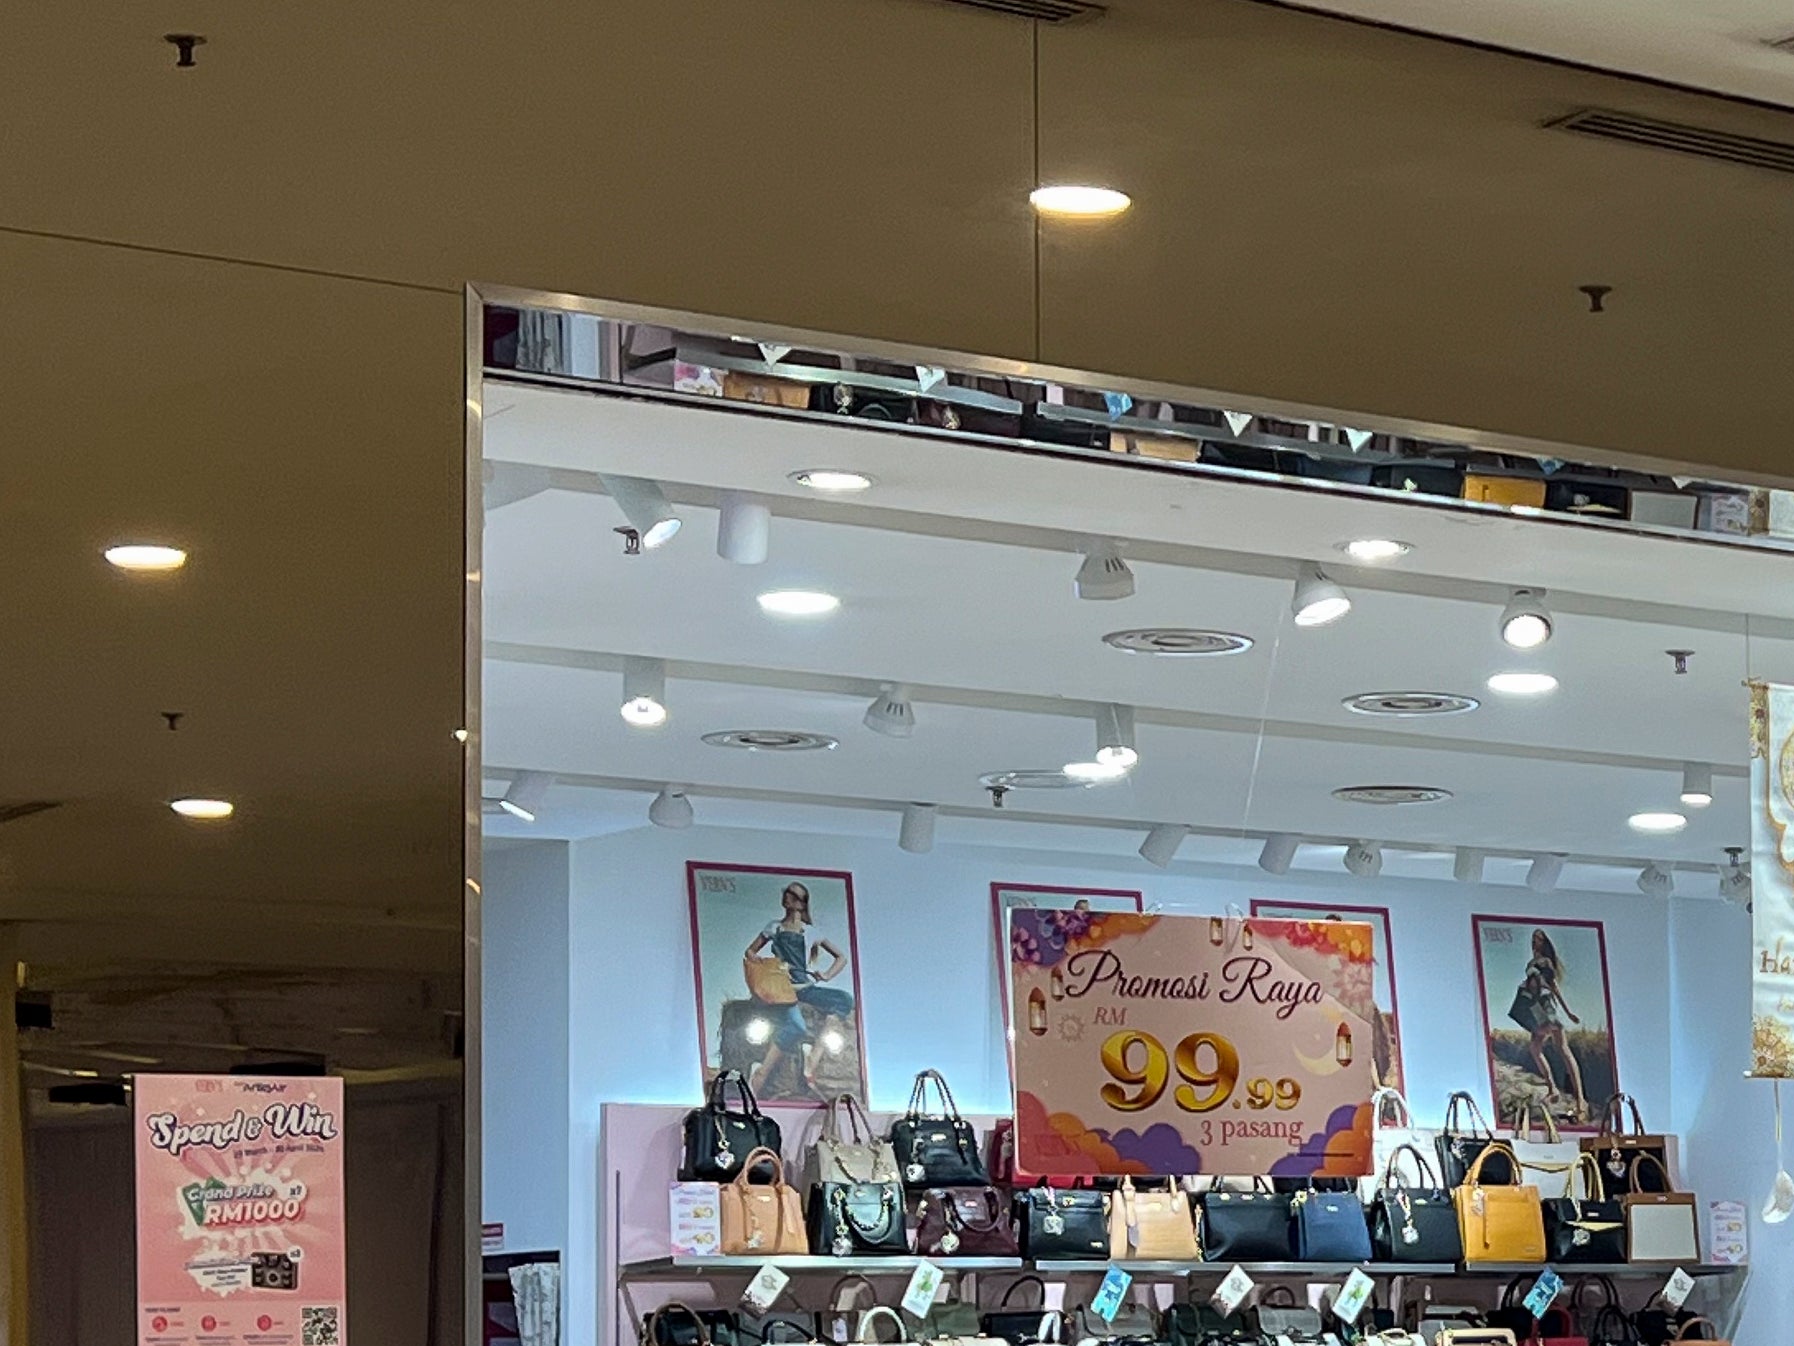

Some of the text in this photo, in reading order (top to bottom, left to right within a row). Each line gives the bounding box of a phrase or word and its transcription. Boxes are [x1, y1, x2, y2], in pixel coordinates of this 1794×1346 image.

[1065, 949, 1324, 1019] Promosi Raya
[1093, 1006, 1129, 1027] RM
[1100, 1028, 1303, 1114] 99.99
[147, 1102, 338, 1157] Spend & Win
[1200, 1119, 1304, 1149] 3 pasang
[187, 1183, 276, 1201] Grand Prize
[202, 1198, 301, 1226] RM1000
